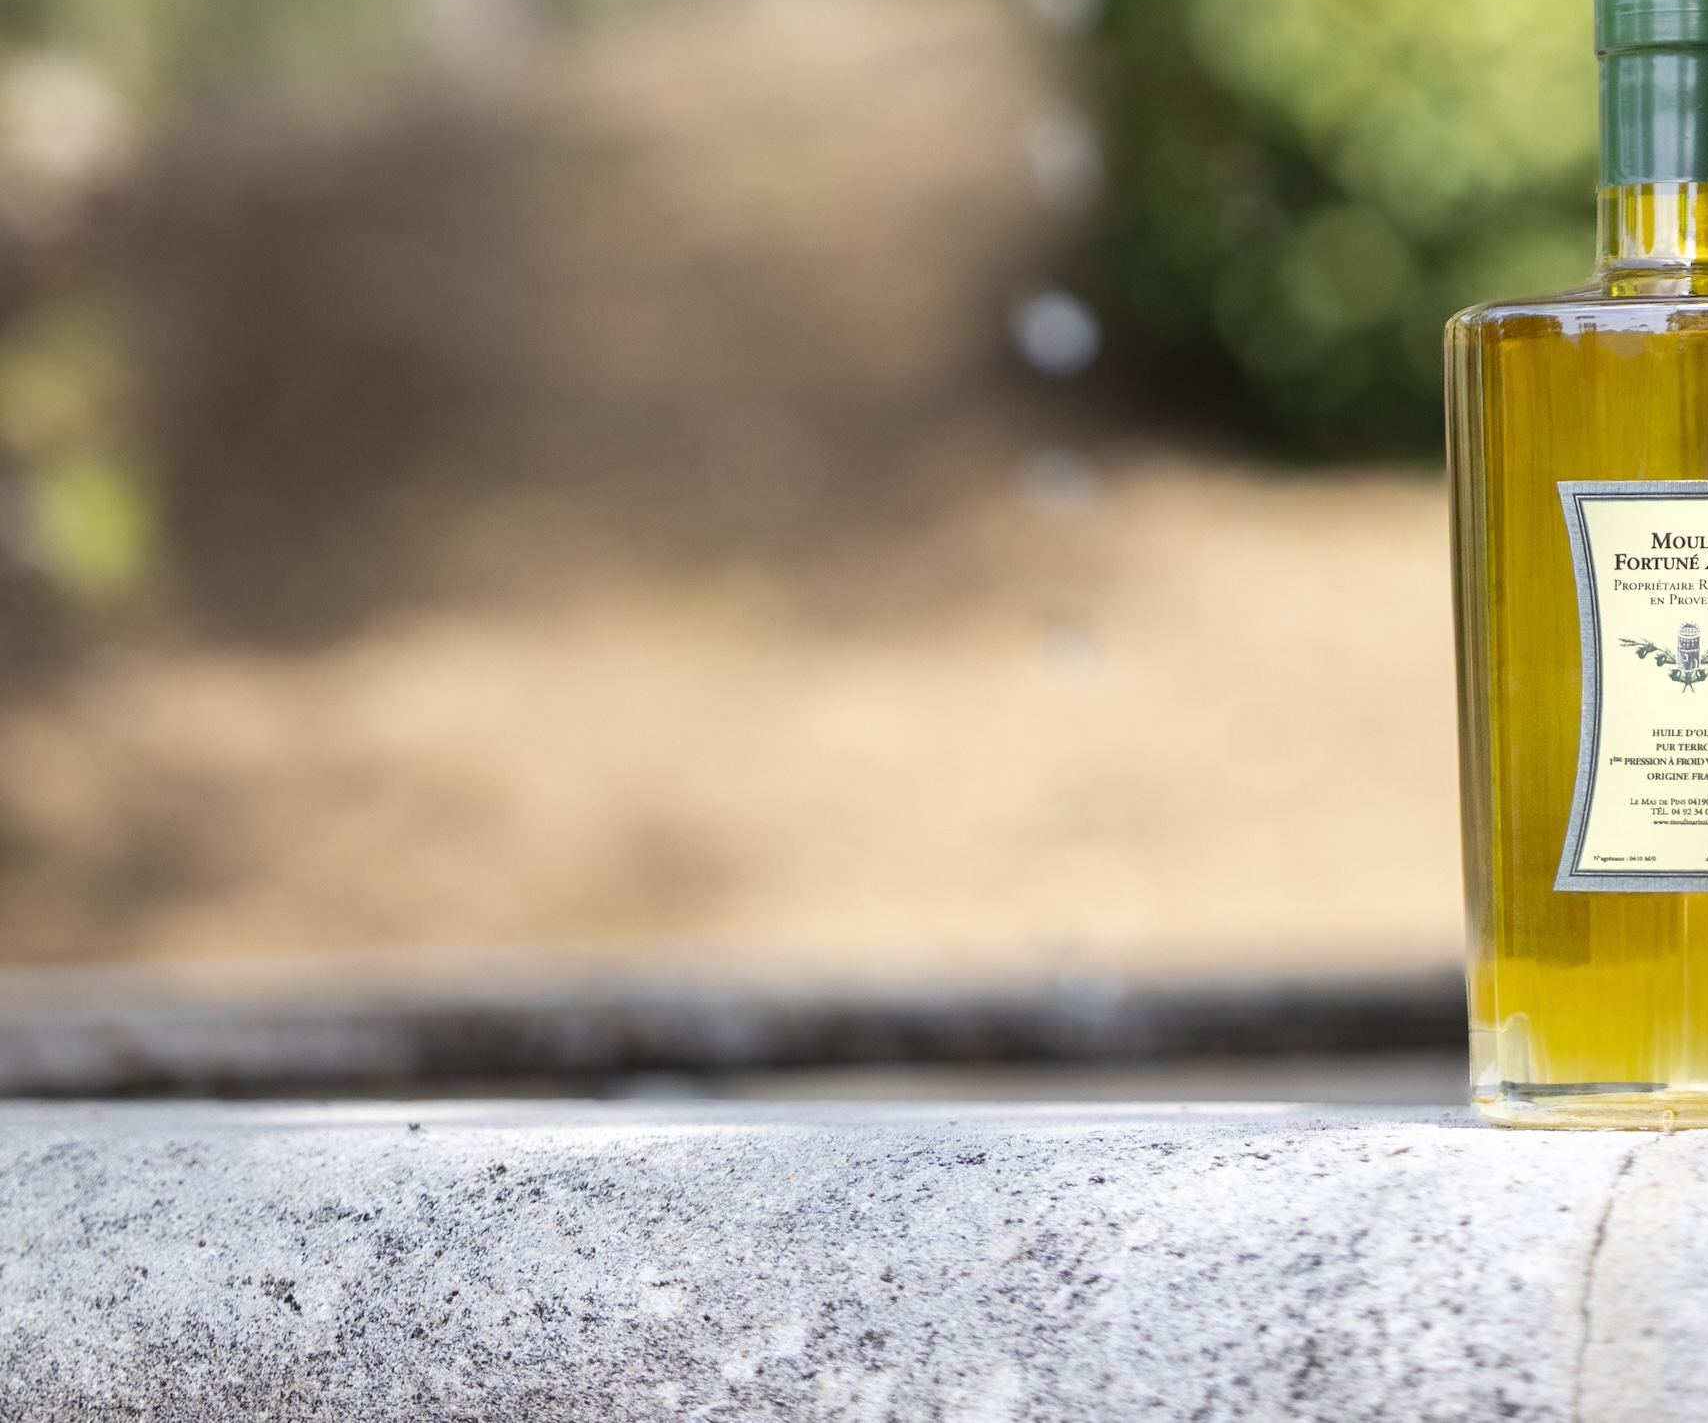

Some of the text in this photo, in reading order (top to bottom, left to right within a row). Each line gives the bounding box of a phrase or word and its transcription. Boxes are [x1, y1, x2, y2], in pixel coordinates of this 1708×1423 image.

[1614, 553, 1699, 570] FORTUNÉ
[1613, 579, 1694, 590] PROPRIÉTAIRE
[1650, 597, 1664, 605] EN
[1652, 729, 1683, 737] HUILE
[1656, 743, 1676, 751] PUR
[1624, 757, 1667, 765] PRESSION
[1668, 756, 1675, 765] À
[1676, 757, 1704, 765] FROID
[1647, 772, 1689, 780] ORIGINE
[1641, 797, 1657, 805] MAS
[1670, 797, 1686, 805] PINS
